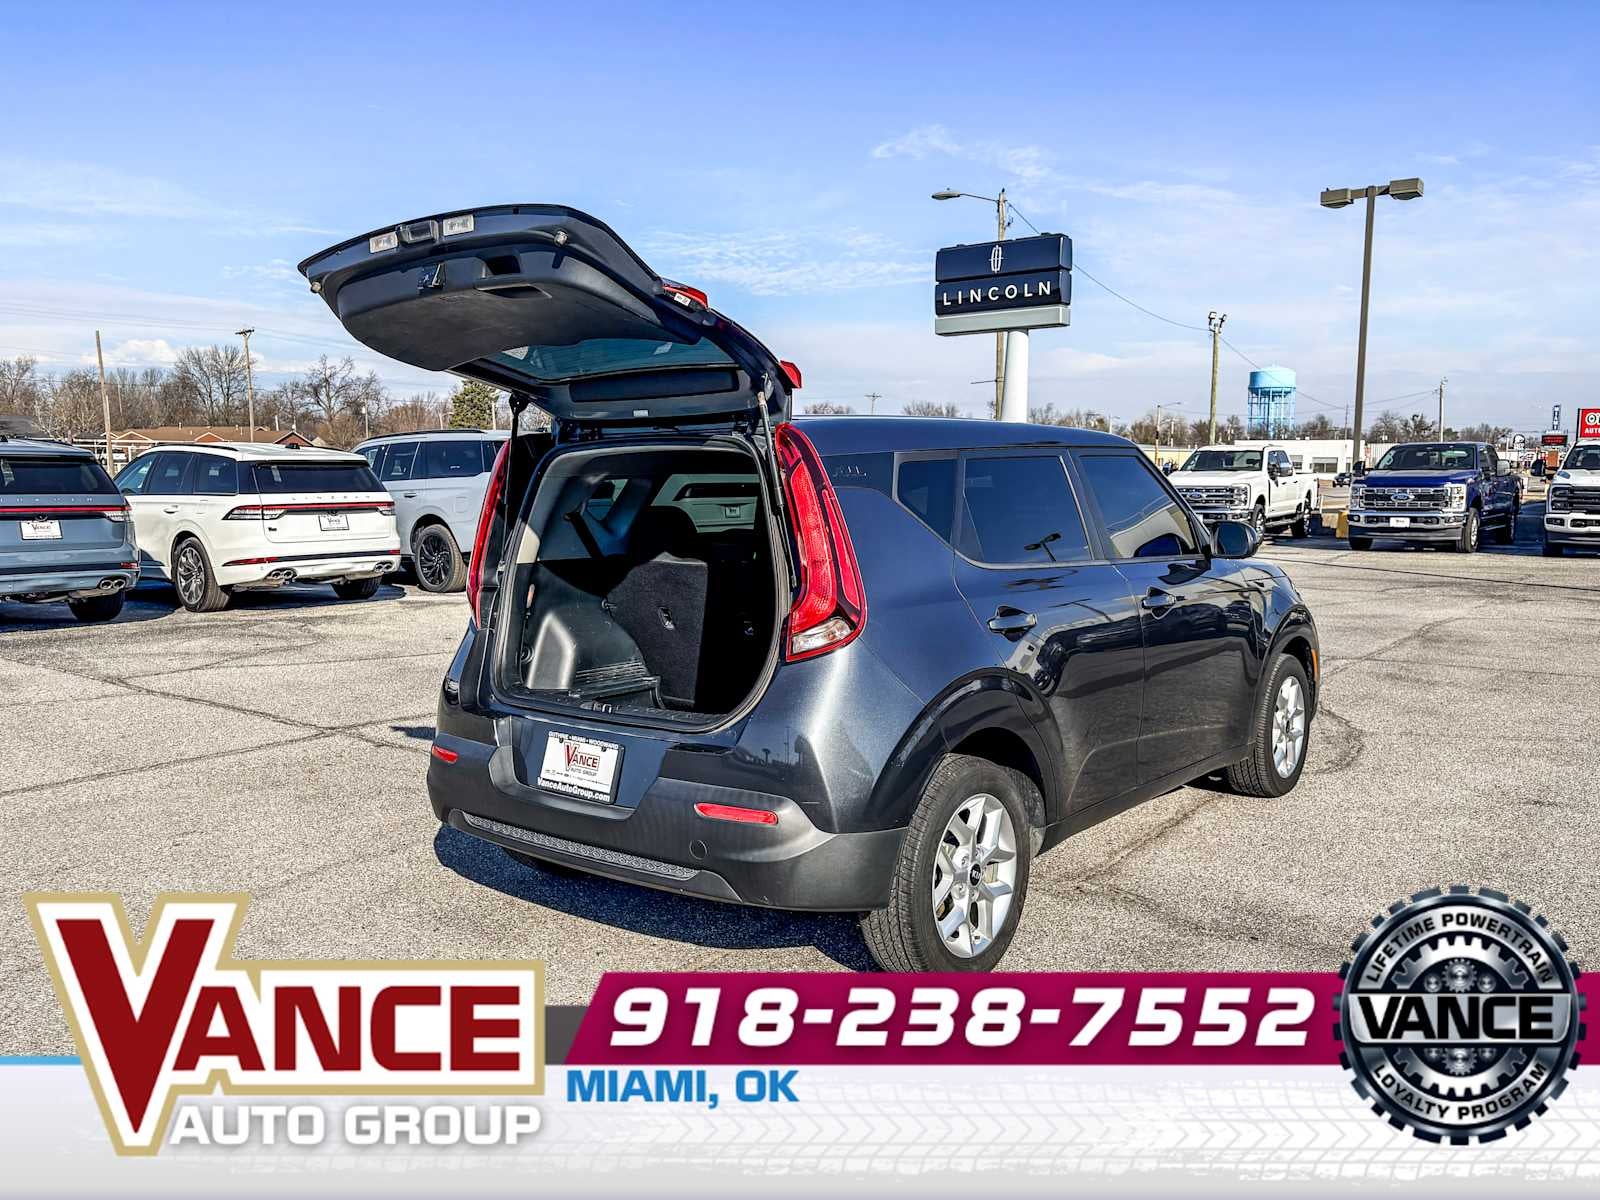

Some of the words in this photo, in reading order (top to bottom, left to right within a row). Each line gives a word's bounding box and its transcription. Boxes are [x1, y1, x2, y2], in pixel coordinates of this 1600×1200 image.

[943, 281, 1051, 306] LINCOLN
[566, 744, 598, 768] VANCE
[537, 777, 610, 802] VanceAutoGroup.com
